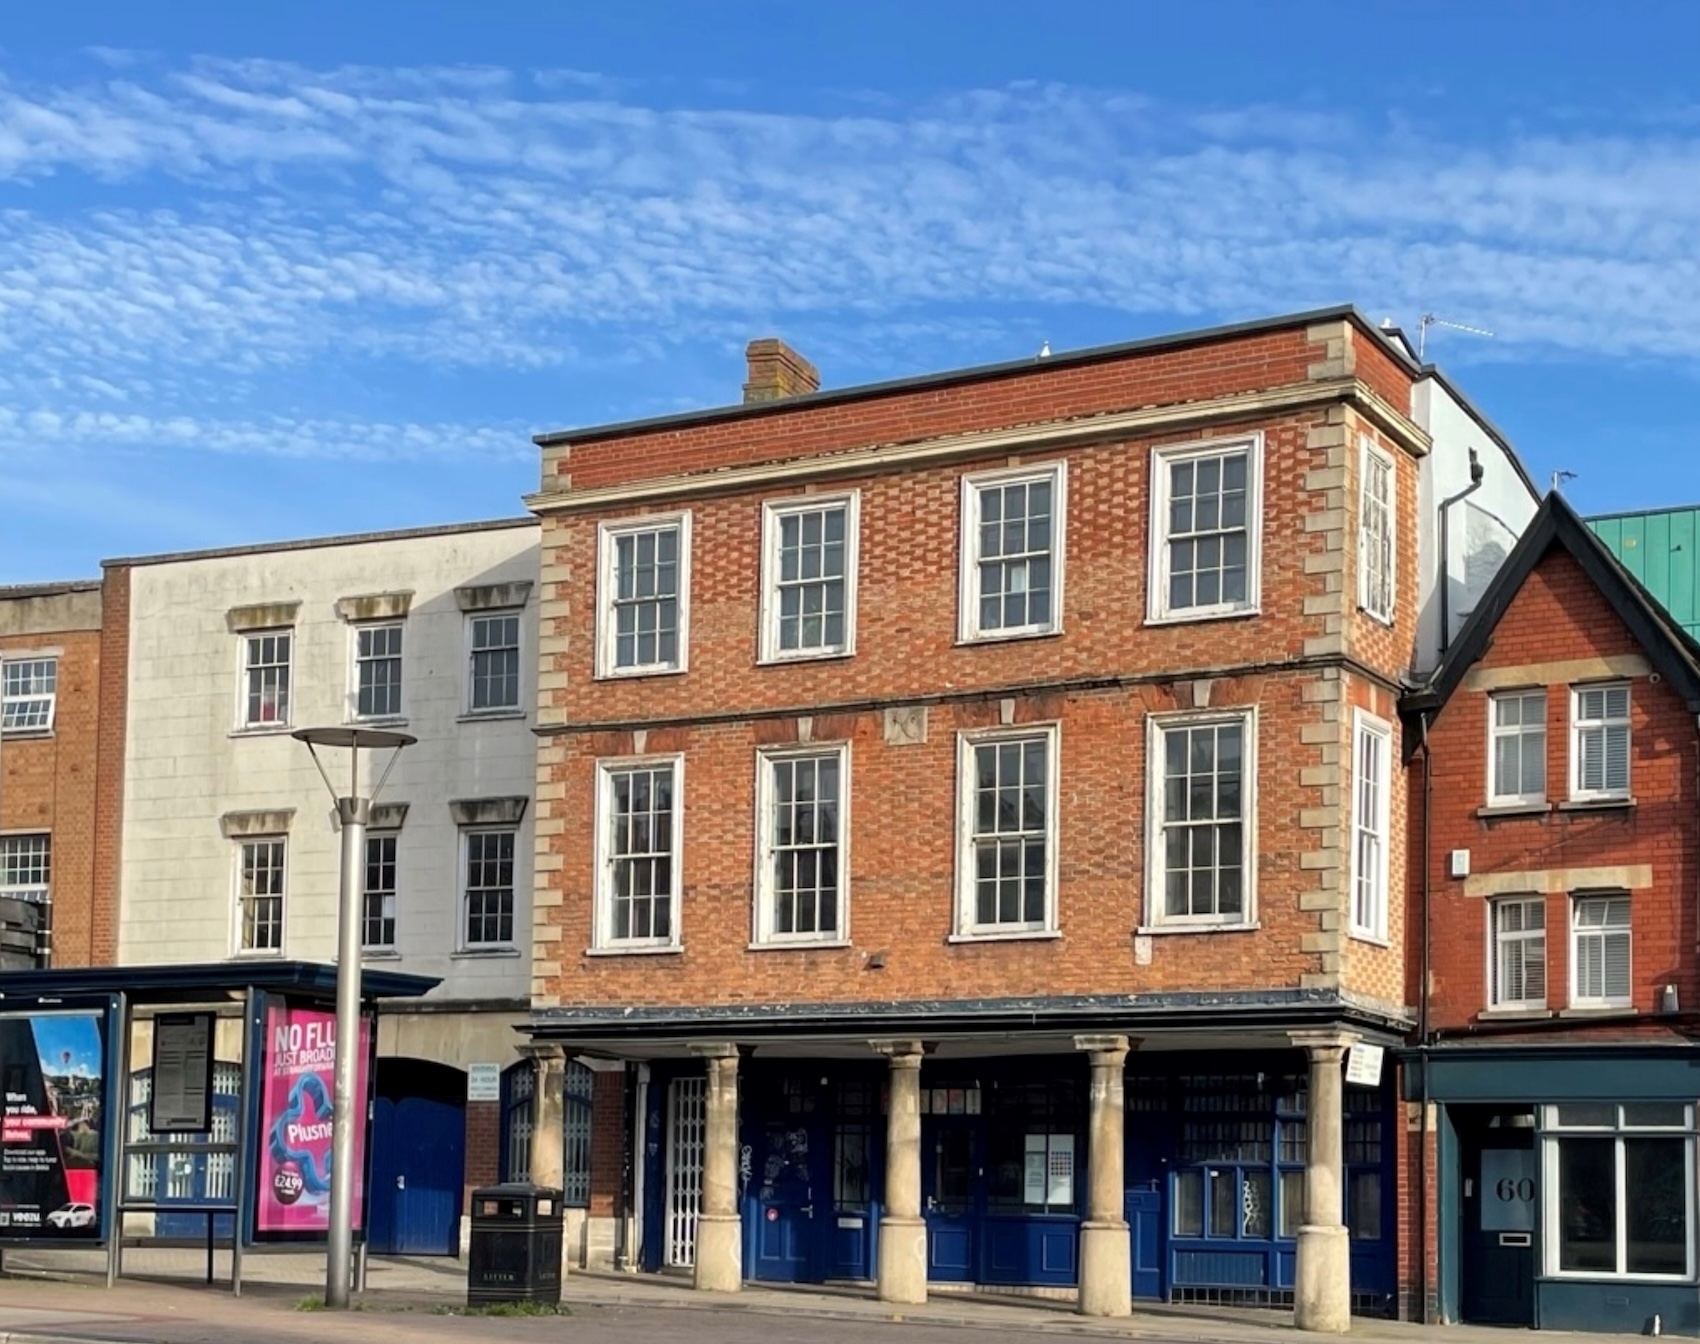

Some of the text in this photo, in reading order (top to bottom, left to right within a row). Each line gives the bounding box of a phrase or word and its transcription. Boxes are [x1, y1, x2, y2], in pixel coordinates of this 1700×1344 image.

[275, 1021, 336, 1052] NO FLU
[275, 1048, 336, 1067] JUST BROAD
[288, 1122, 333, 1144] Plusne
[274, 1175, 303, 1190] £24.99
[1496, 1178, 1535, 1202] 60
